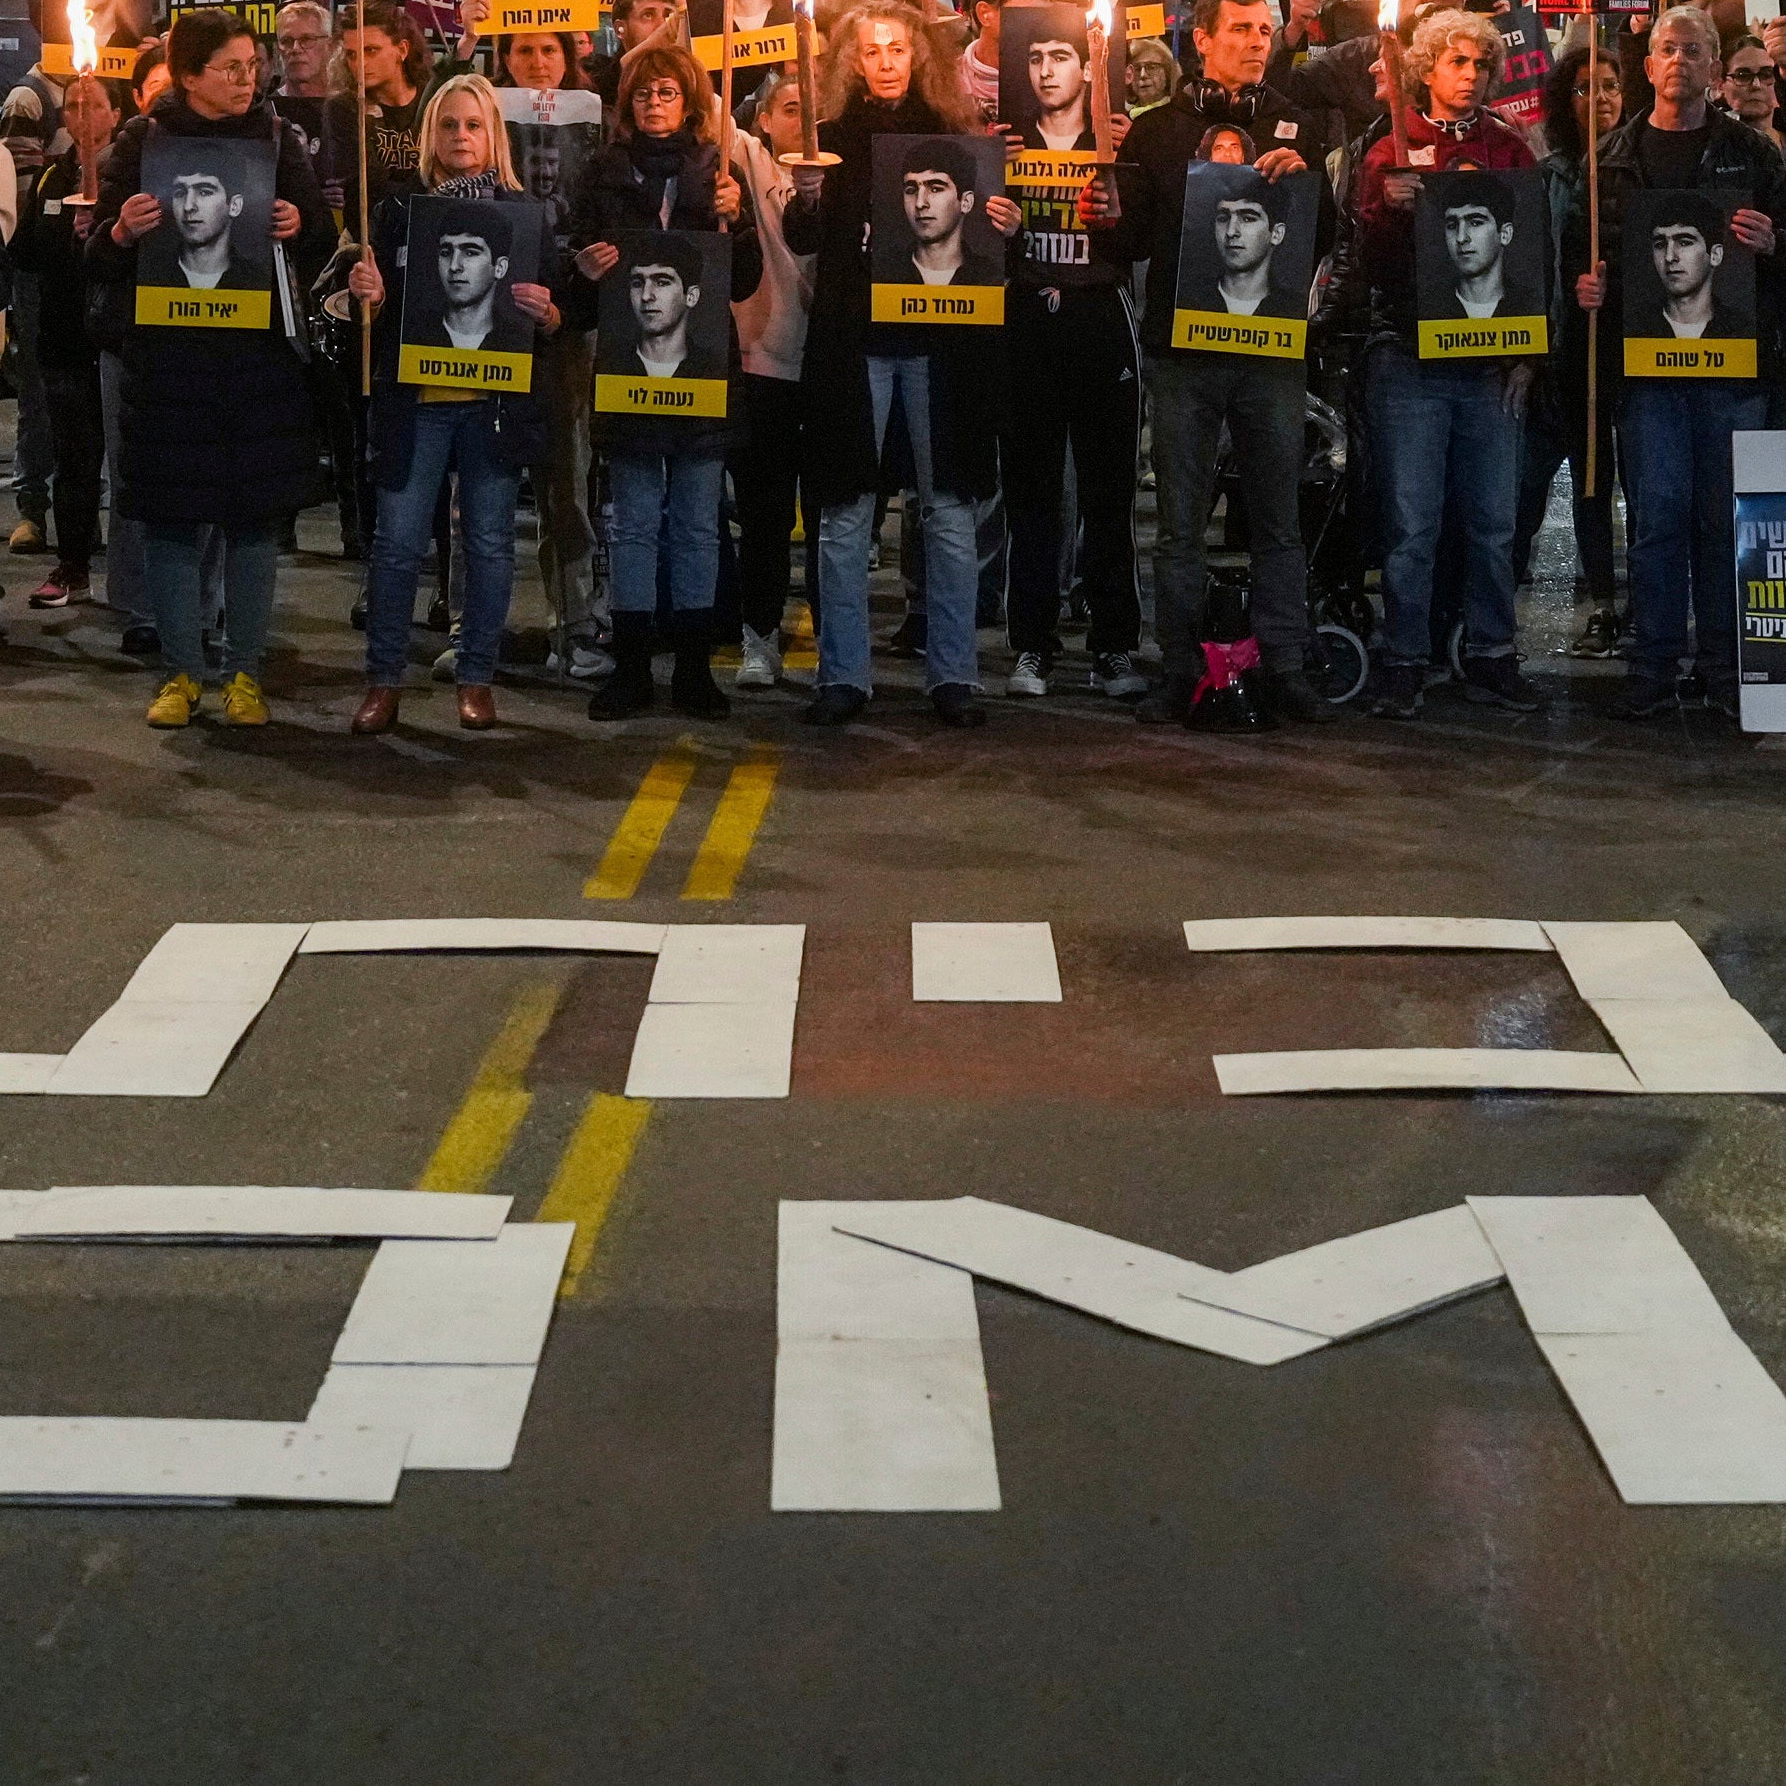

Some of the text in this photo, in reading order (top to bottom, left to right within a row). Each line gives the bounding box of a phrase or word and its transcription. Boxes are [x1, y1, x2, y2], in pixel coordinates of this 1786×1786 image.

[501, 7, 571, 29] איתן הורן
[755, 36, 787, 56] דרור
[101, 56, 127, 73] ירדן
[1011, 160, 1053, 178] גלבוע
[1022, 230, 1091, 265] בעזה?
[167, 299, 239, 319] יאיר הורן
[900, 296, 976, 316] נמרוד כהן
[1187, 322, 1293, 349] בר קופרשטיין
[1434, 328, 1532, 351] מתן צנגאוקר
[1654, 347, 1726, 369] טל שוהם
[418, 356, 514, 383] מתן אנגרסט
[628, 385, 695, 407] נעמה לוי
